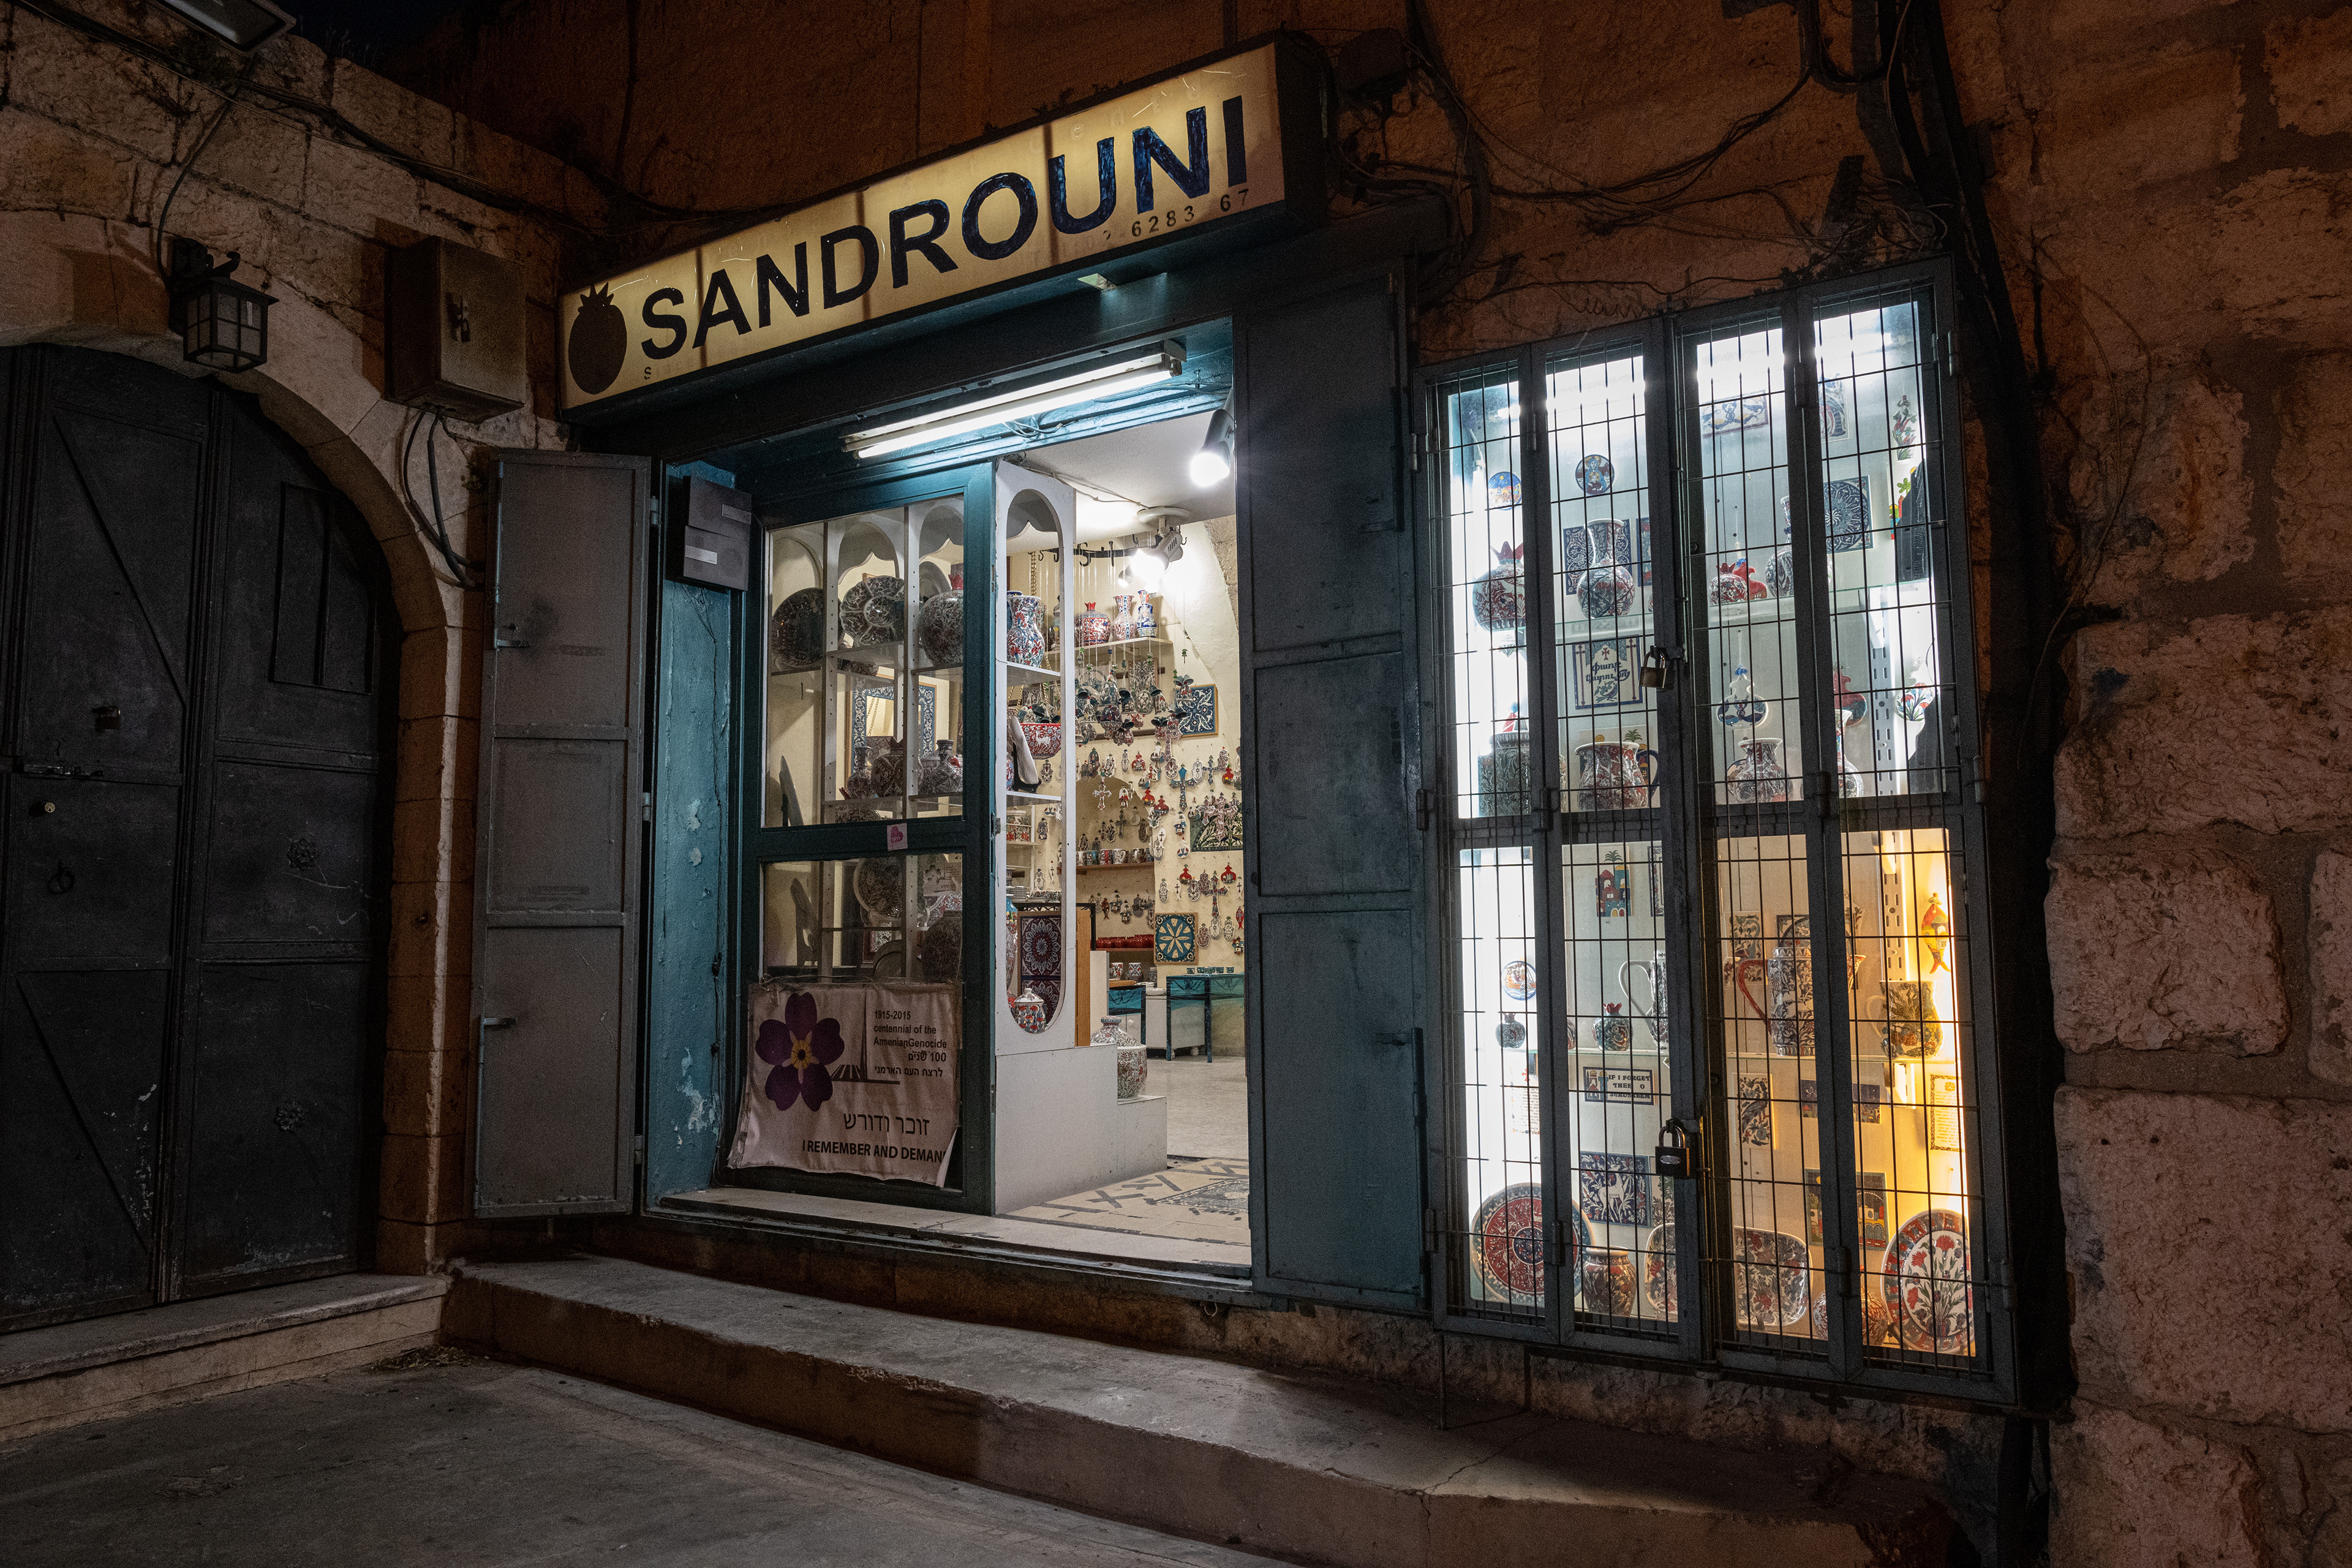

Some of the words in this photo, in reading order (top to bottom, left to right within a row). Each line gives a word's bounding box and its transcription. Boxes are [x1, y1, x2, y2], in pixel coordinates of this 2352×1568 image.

[641, 96, 1246, 360] SANDROUNI
[875, 1010, 911, 1020] 1915-2015
[874, 1024, 911, 1033] centennial
[914, 1025, 922, 1034] of
[924, 1025, 937, 1034] the
[908, 1052, 927, 1061] שנים
[930, 1052, 946, 1061] 100
[875, 1066, 901, 1074] הארמני
[922, 1067, 943, 1077] לרצח
[843, 1113, 890, 1133] ודורש
[895, 1116, 930, 1135] זוכר
[802, 1140, 805, 1152] I
[807, 1140, 871, 1156] REMEMBER
[873, 1144, 898, 1159] AND
[901, 1147, 947, 1164] DEMAN
